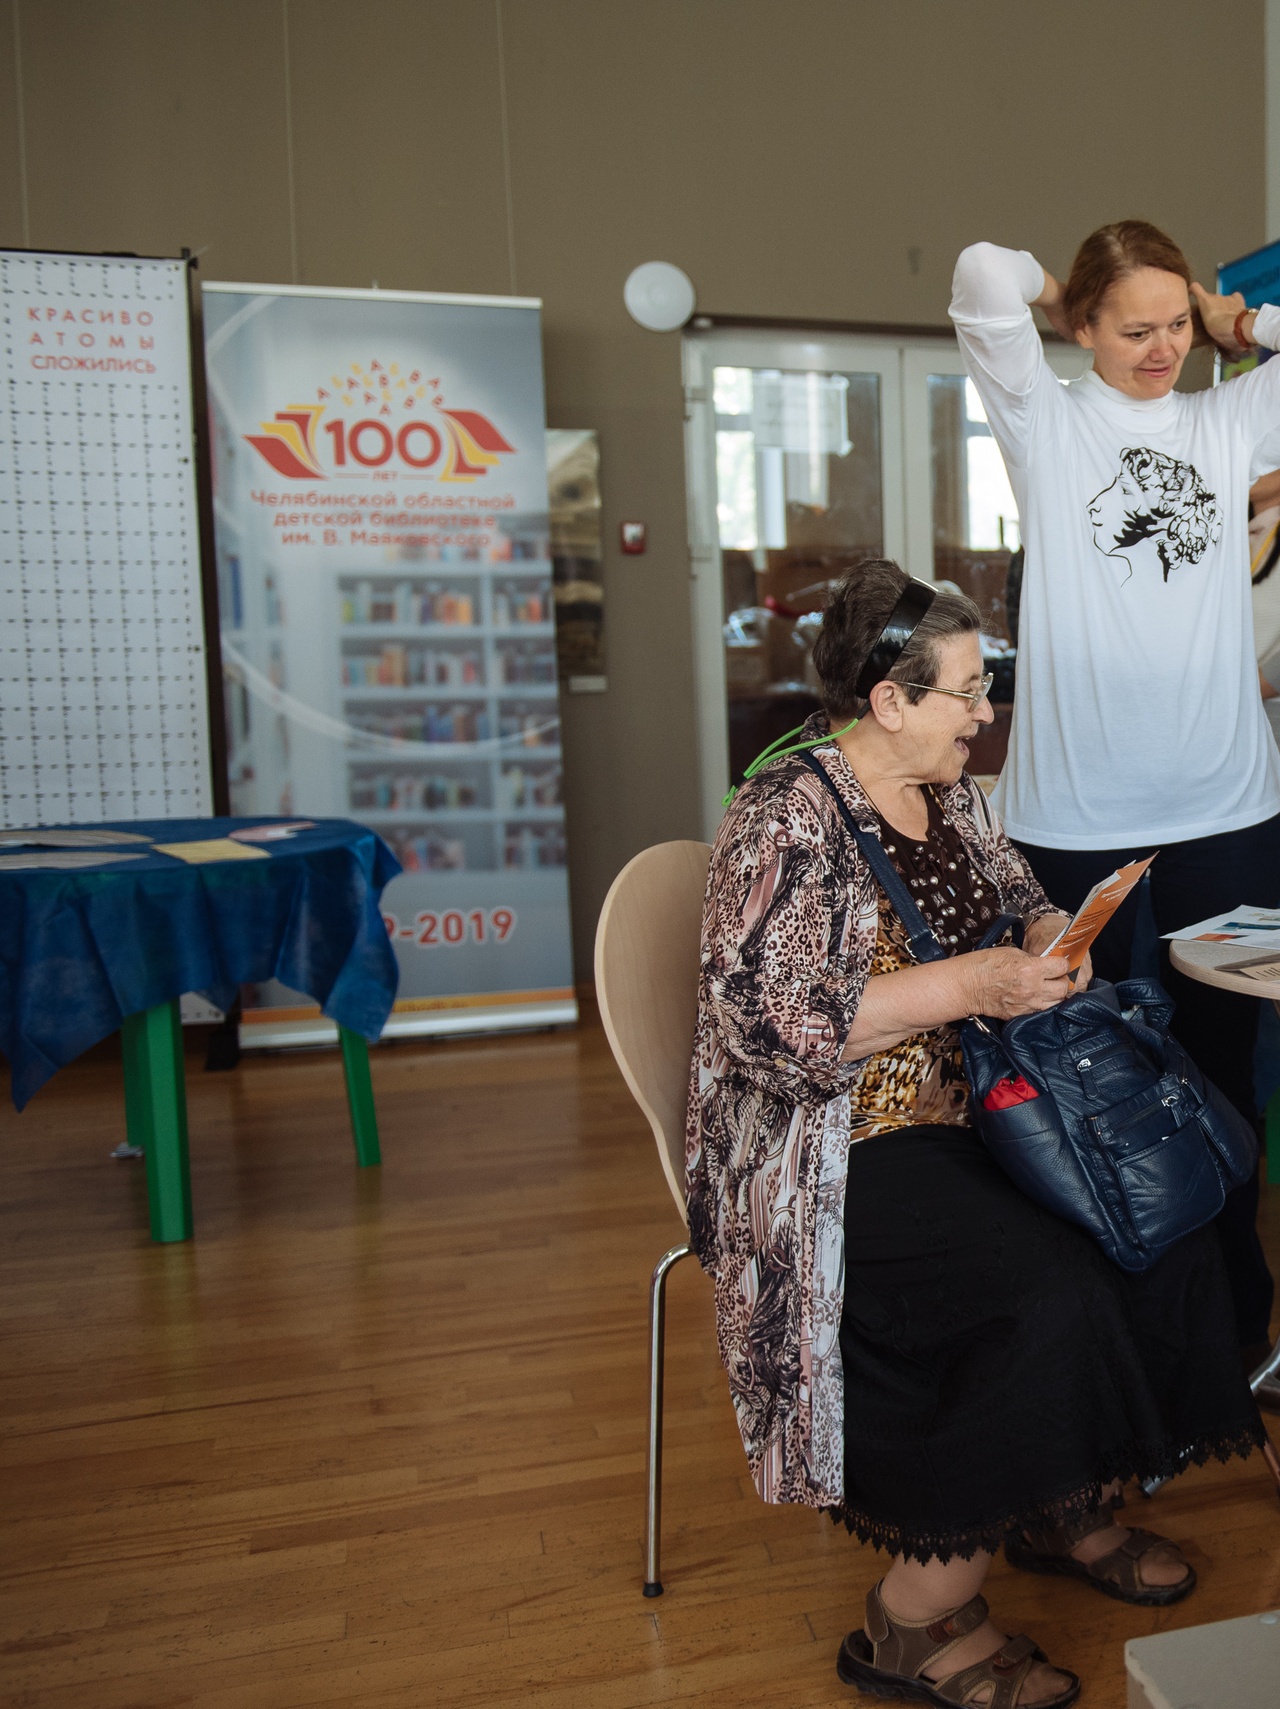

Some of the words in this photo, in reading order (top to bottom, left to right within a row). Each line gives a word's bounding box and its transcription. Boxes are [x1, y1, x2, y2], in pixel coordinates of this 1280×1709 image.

[27, 307, 153, 327] КРАСИВО
[29, 332, 155, 350] АТОМЫ
[30, 355, 157, 374] СЛОЖИЛИСЬ
[324, 418, 442, 469] 100
[372, 471, 399, 481] ЛЕТ
[250, 489, 397, 508] Челябинской
[403, 491, 516, 509] областной
[273, 510, 363, 528] детской
[369, 510, 496, 529] библиотеке
[281, 531, 314, 546] им.
[350, 529, 491, 549] Маяковского
